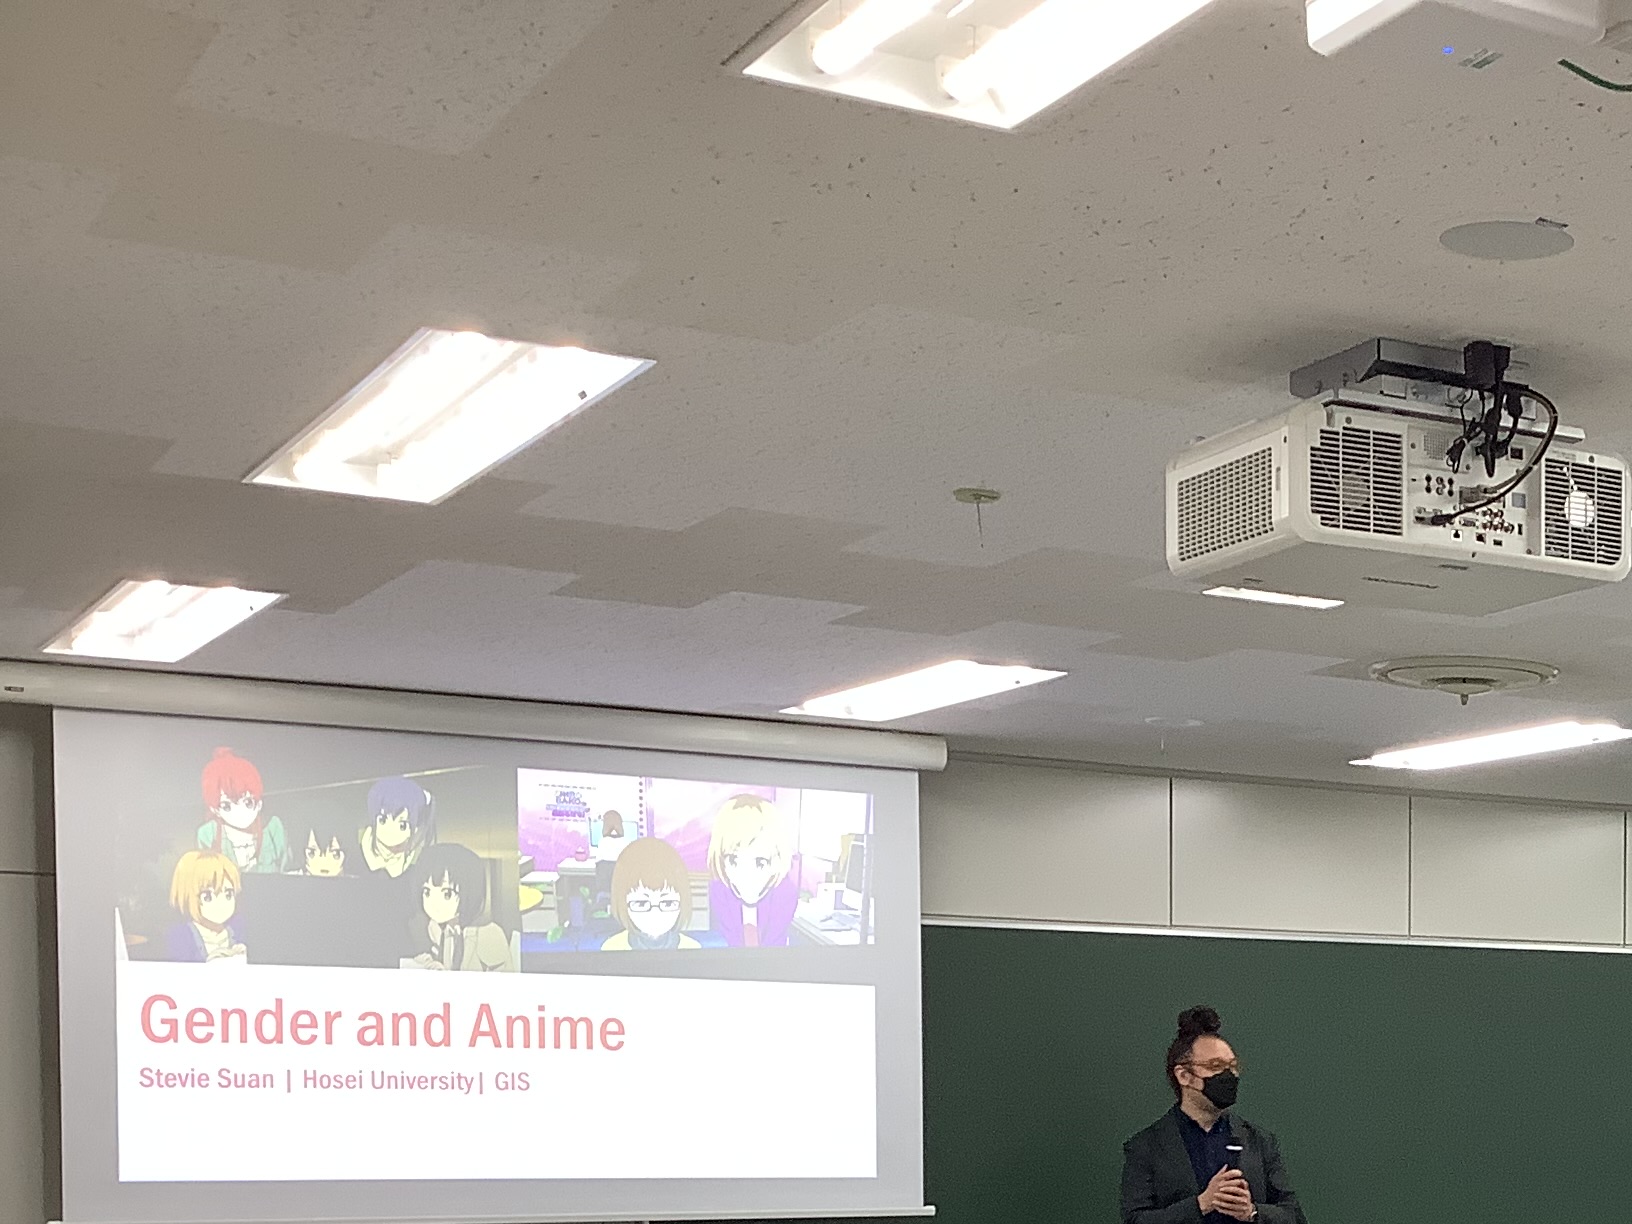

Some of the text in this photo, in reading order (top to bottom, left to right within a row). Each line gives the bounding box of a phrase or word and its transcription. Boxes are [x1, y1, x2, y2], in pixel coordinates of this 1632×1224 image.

[140, 993, 626, 1052] Gender and Anime
[139, 1066, 211, 1090] Stevie
[217, 1067, 275, 1090] Suan
[303, 1070, 364, 1091] Hosei
[495, 1072, 531, 1093] GIS
